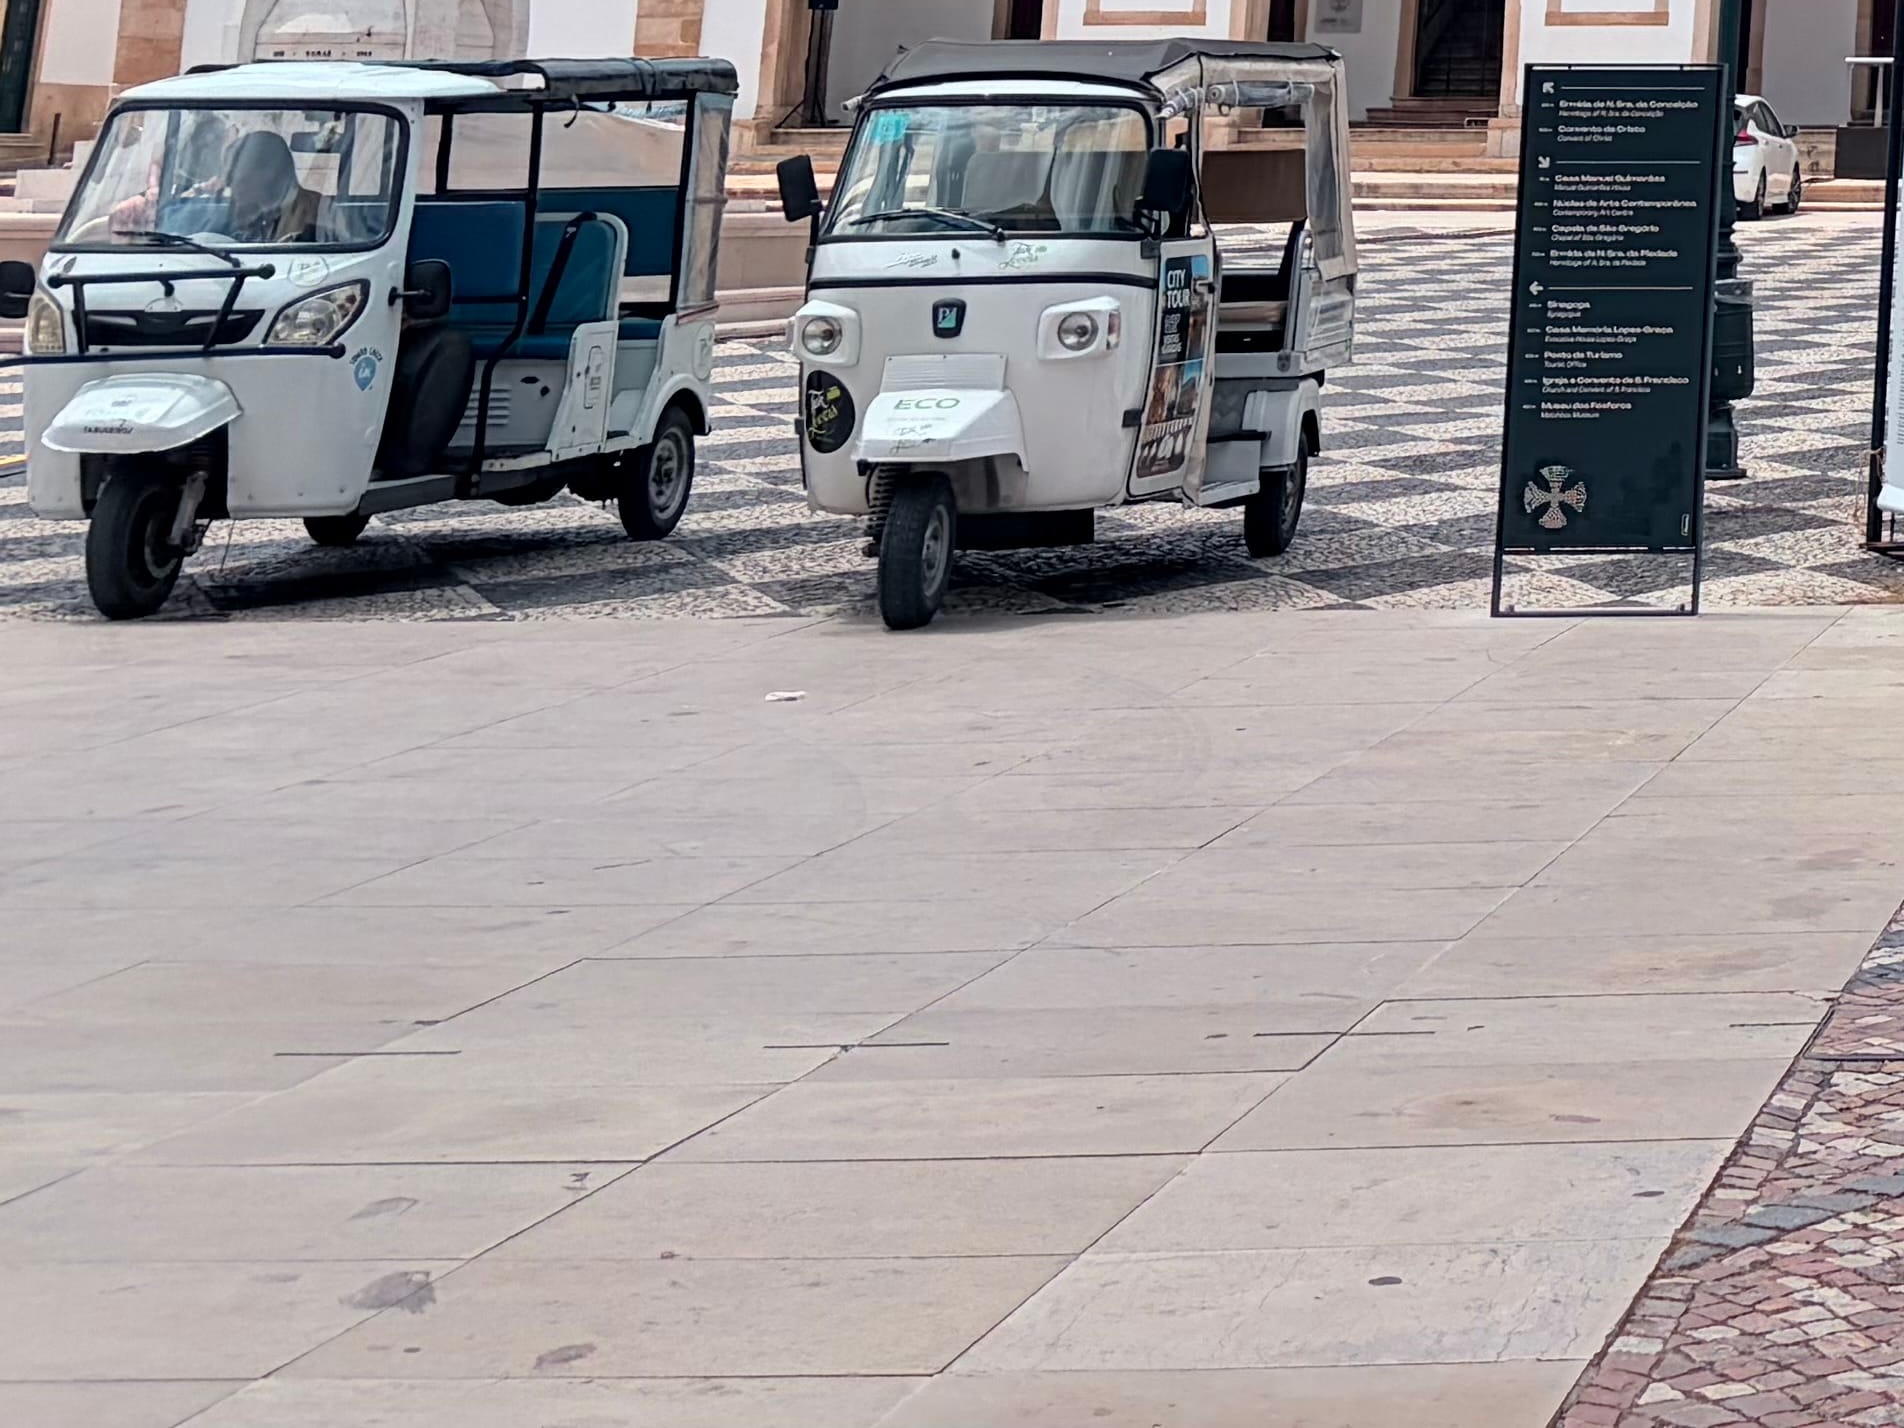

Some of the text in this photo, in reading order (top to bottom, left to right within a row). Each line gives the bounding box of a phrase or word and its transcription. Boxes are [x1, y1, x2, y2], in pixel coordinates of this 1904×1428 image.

[1168, 269, 1186, 289] CITY
[1167, 289, 1190, 309] TOUR
[894, 398, 961, 410] ECO
